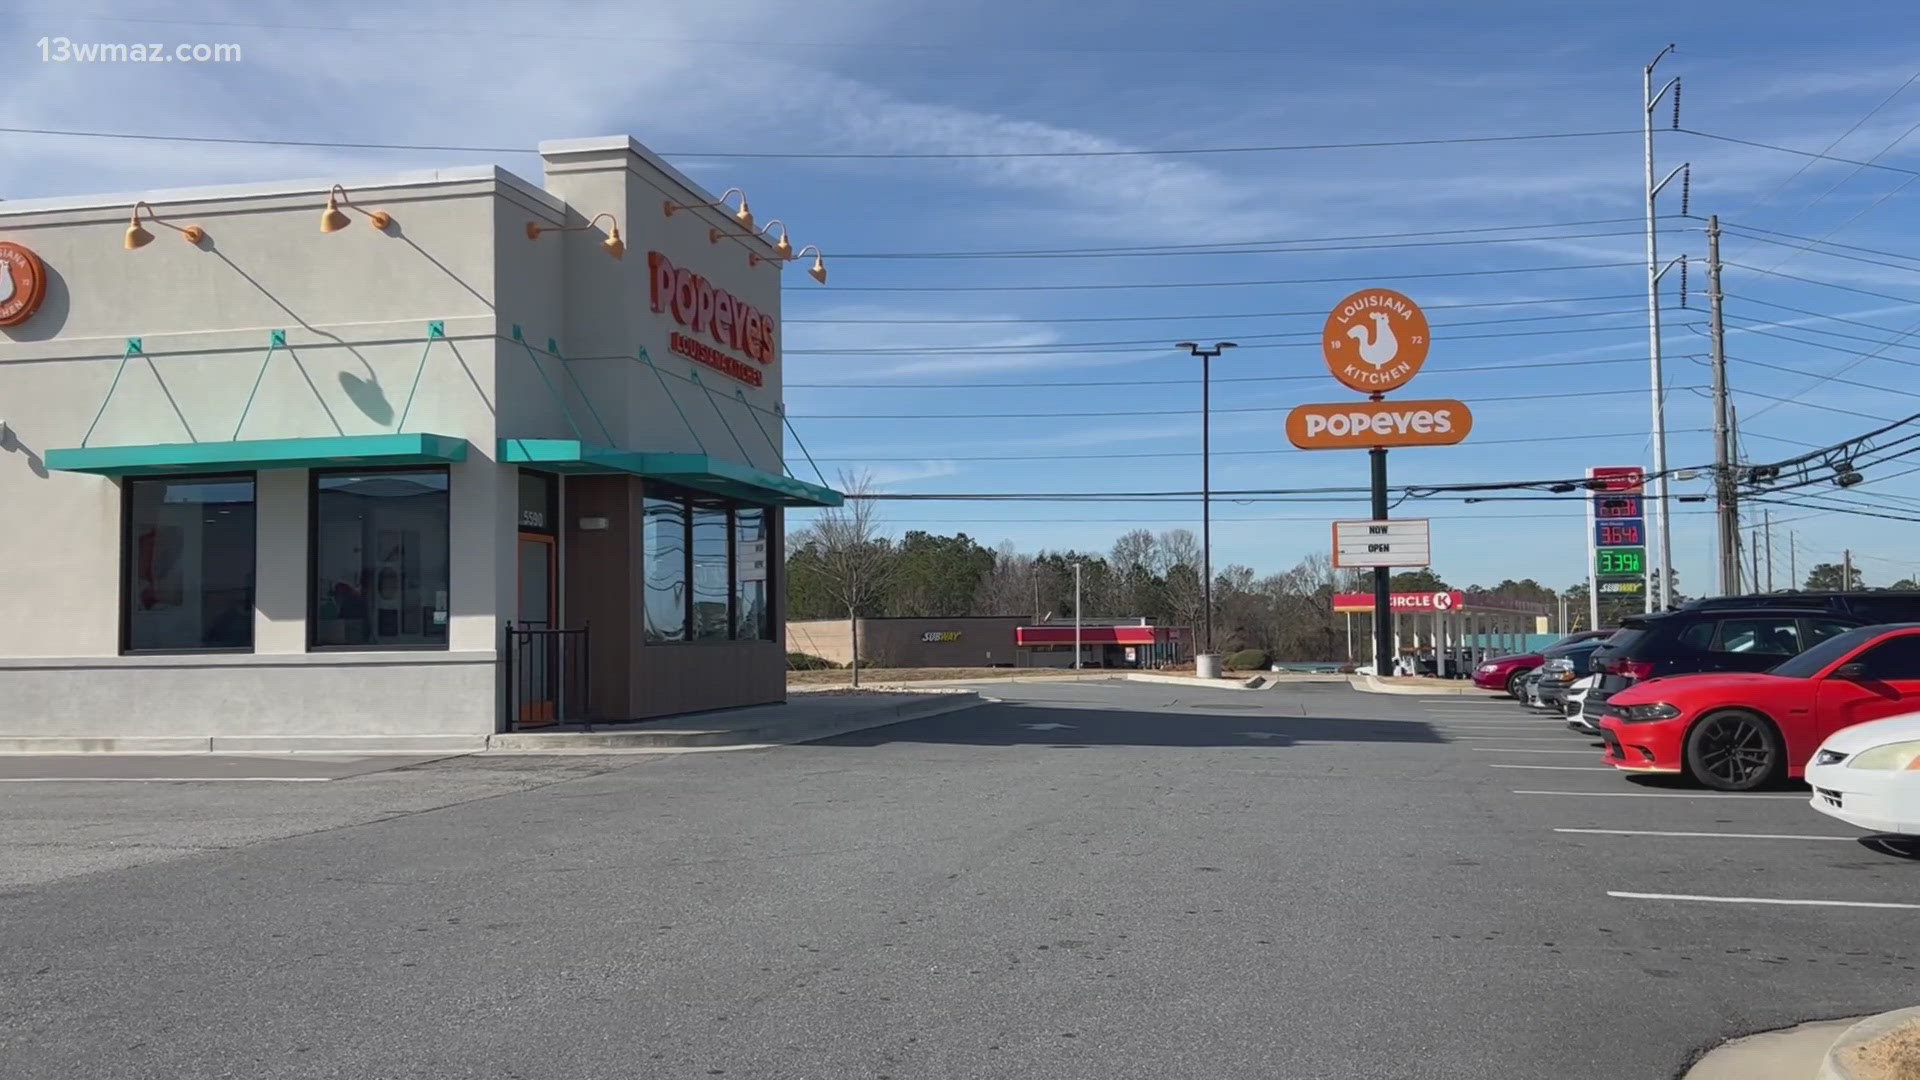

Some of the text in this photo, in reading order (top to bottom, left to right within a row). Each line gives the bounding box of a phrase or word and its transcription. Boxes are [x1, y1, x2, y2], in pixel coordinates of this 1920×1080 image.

[1337, 296, 1413, 324] LOUISIANA
[1411, 336, 1423, 344] 72
[1344, 361, 1411, 384] KITCHEN
[1369, 526, 1388, 534] NOW
[1368, 544, 1390, 553] OPEN
[1599, 583, 1643, 593] SUBWAY
[922, 632, 961, 641] SUBWAY
